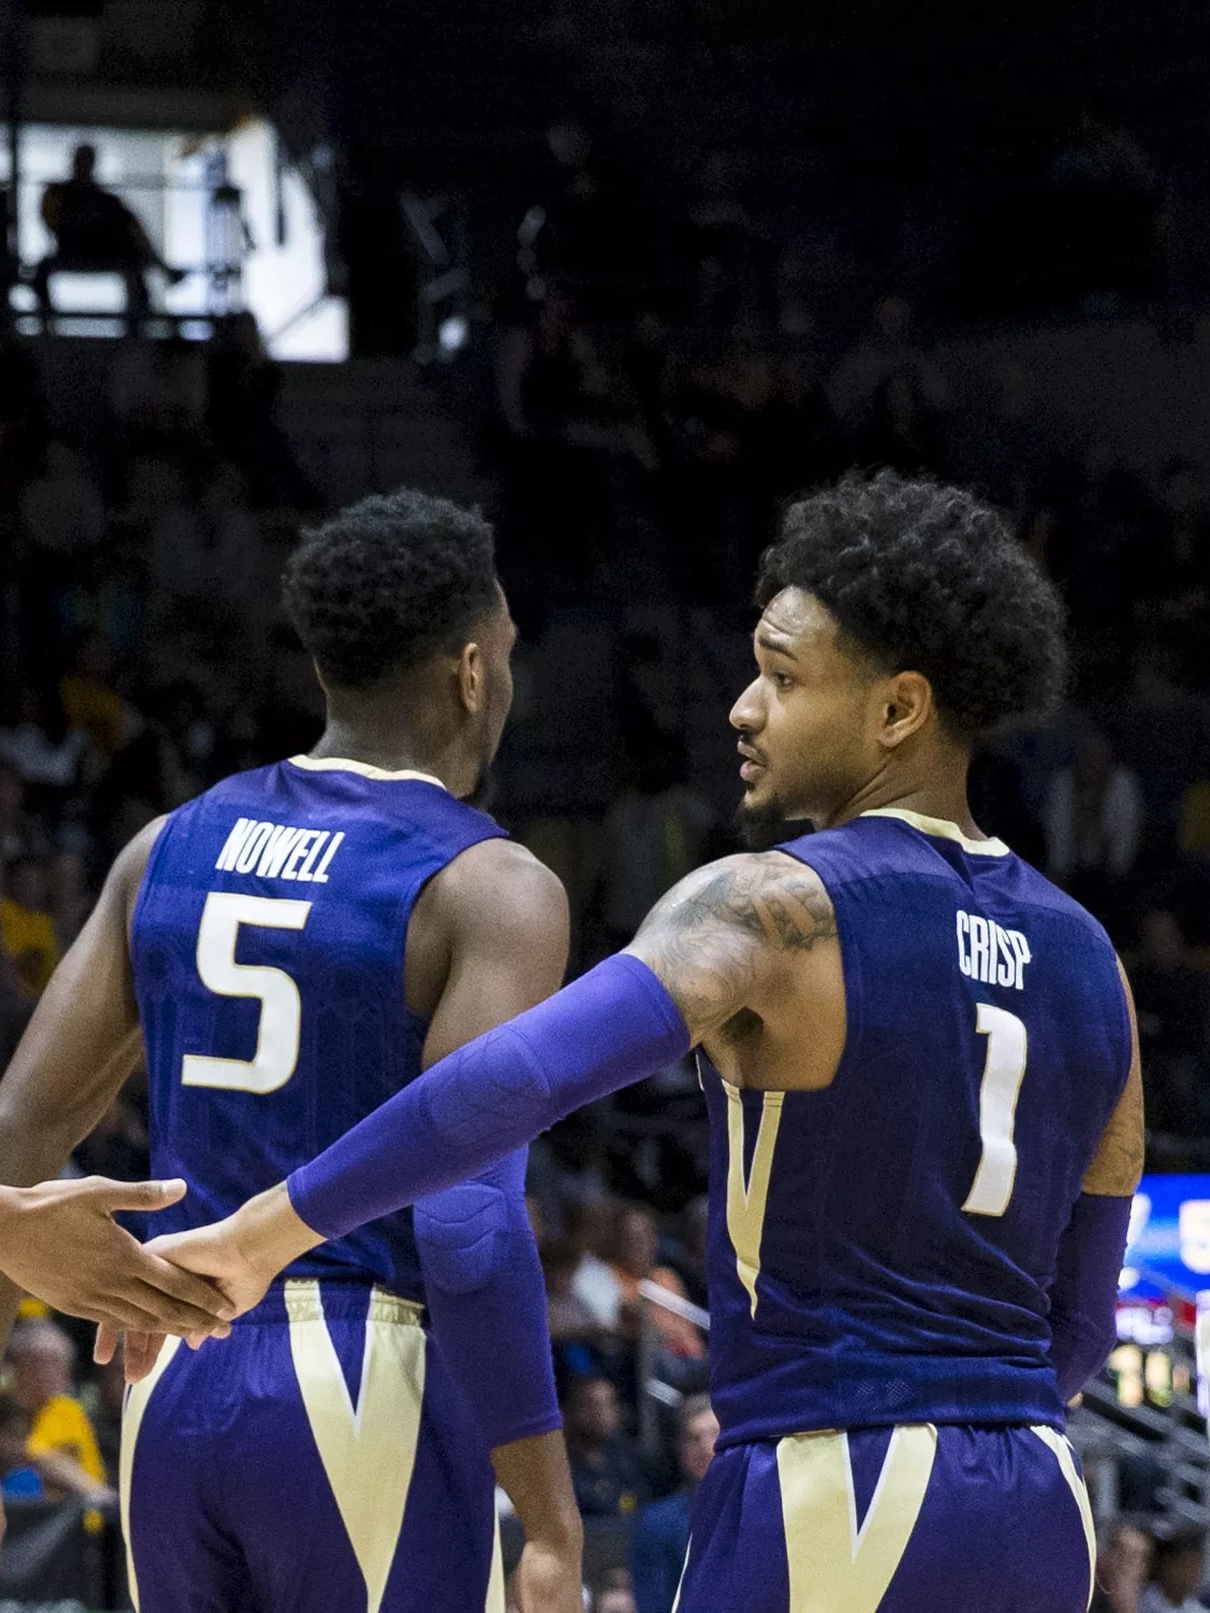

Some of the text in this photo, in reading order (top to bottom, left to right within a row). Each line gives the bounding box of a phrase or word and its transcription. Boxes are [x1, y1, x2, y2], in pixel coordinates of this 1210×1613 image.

[215, 818, 345, 883] NOWELL
[182, 891, 312, 1095] 5
[956, 909, 1031, 990] CRISP
[961, 1002, 1028, 1217] 1
